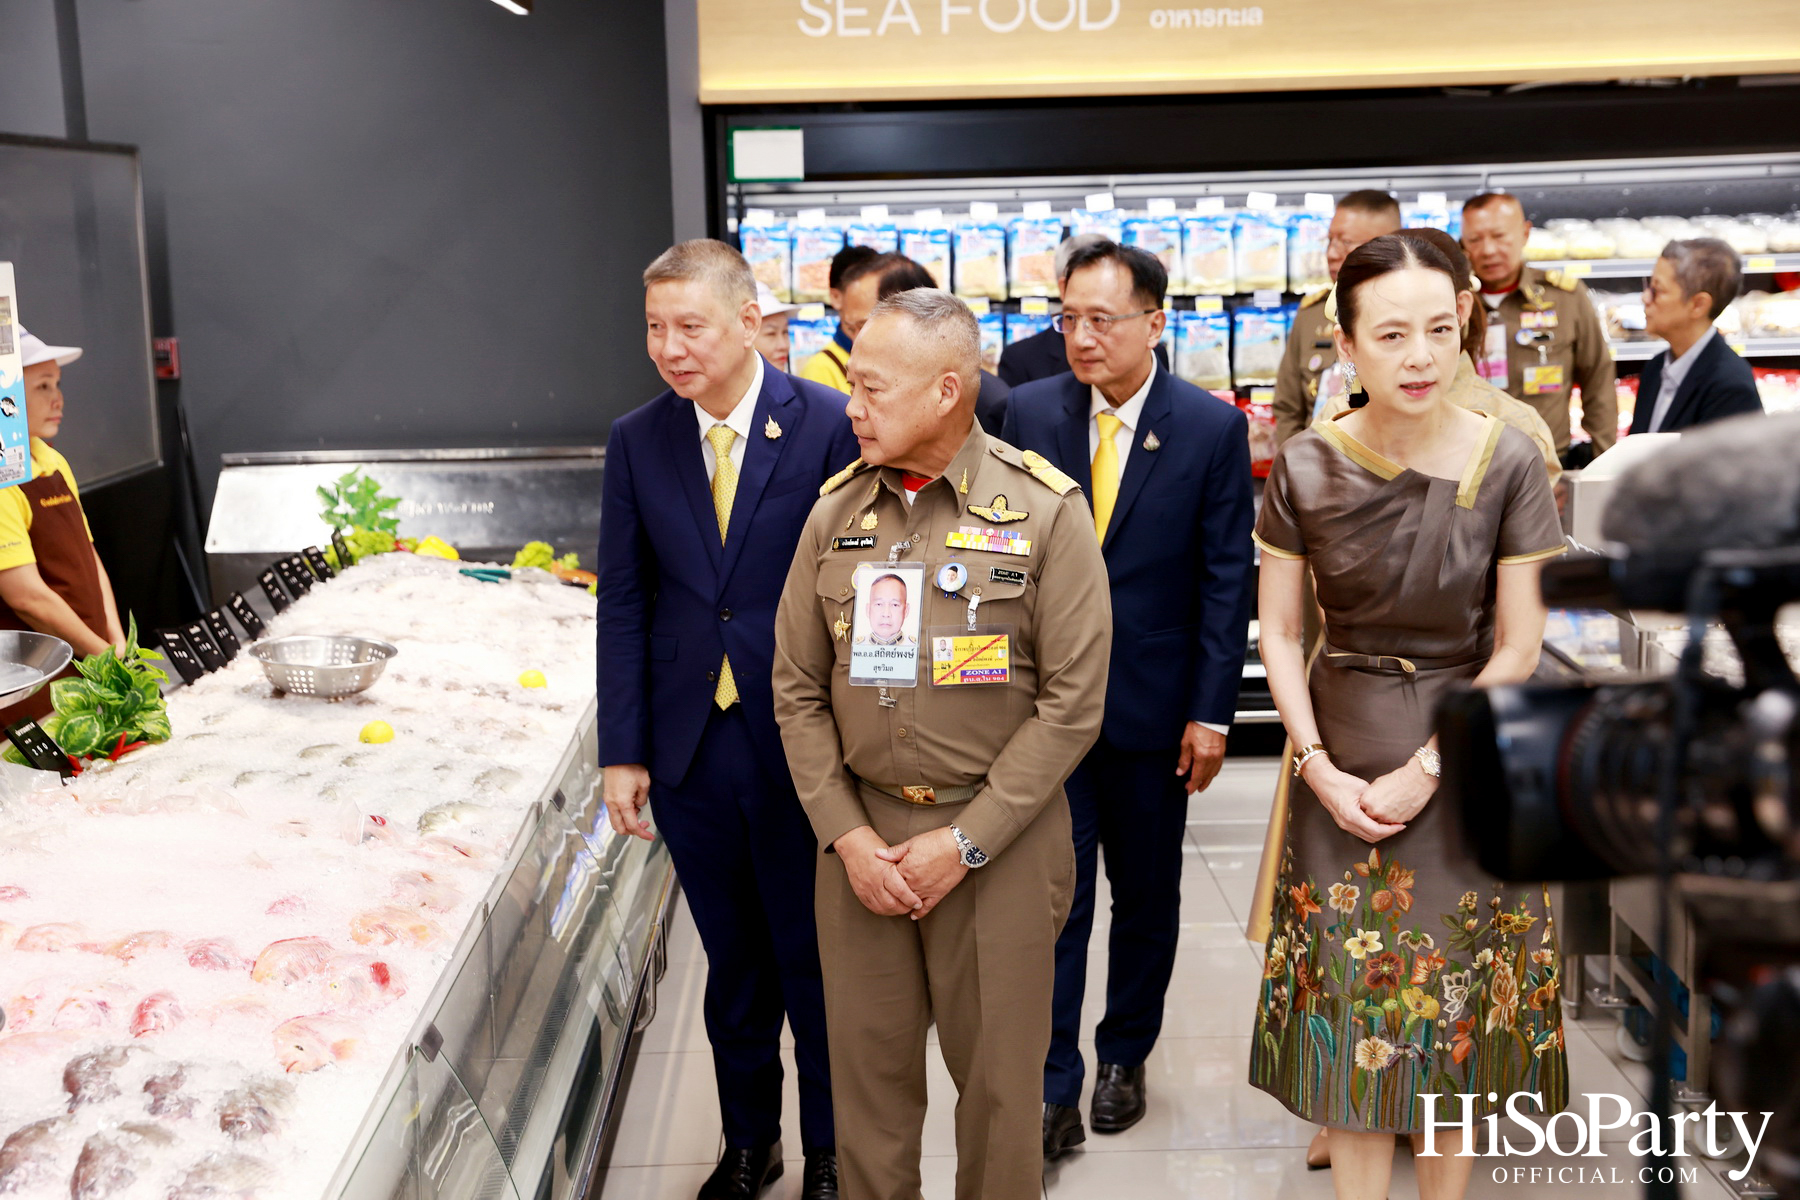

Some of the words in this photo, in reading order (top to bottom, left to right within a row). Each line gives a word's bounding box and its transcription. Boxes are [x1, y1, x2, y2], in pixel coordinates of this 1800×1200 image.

[797, 0, 921, 37] SEA
[941, 0, 1121, 35] FOOD
[1149, 6, 1264, 30] อาหารทะเล
